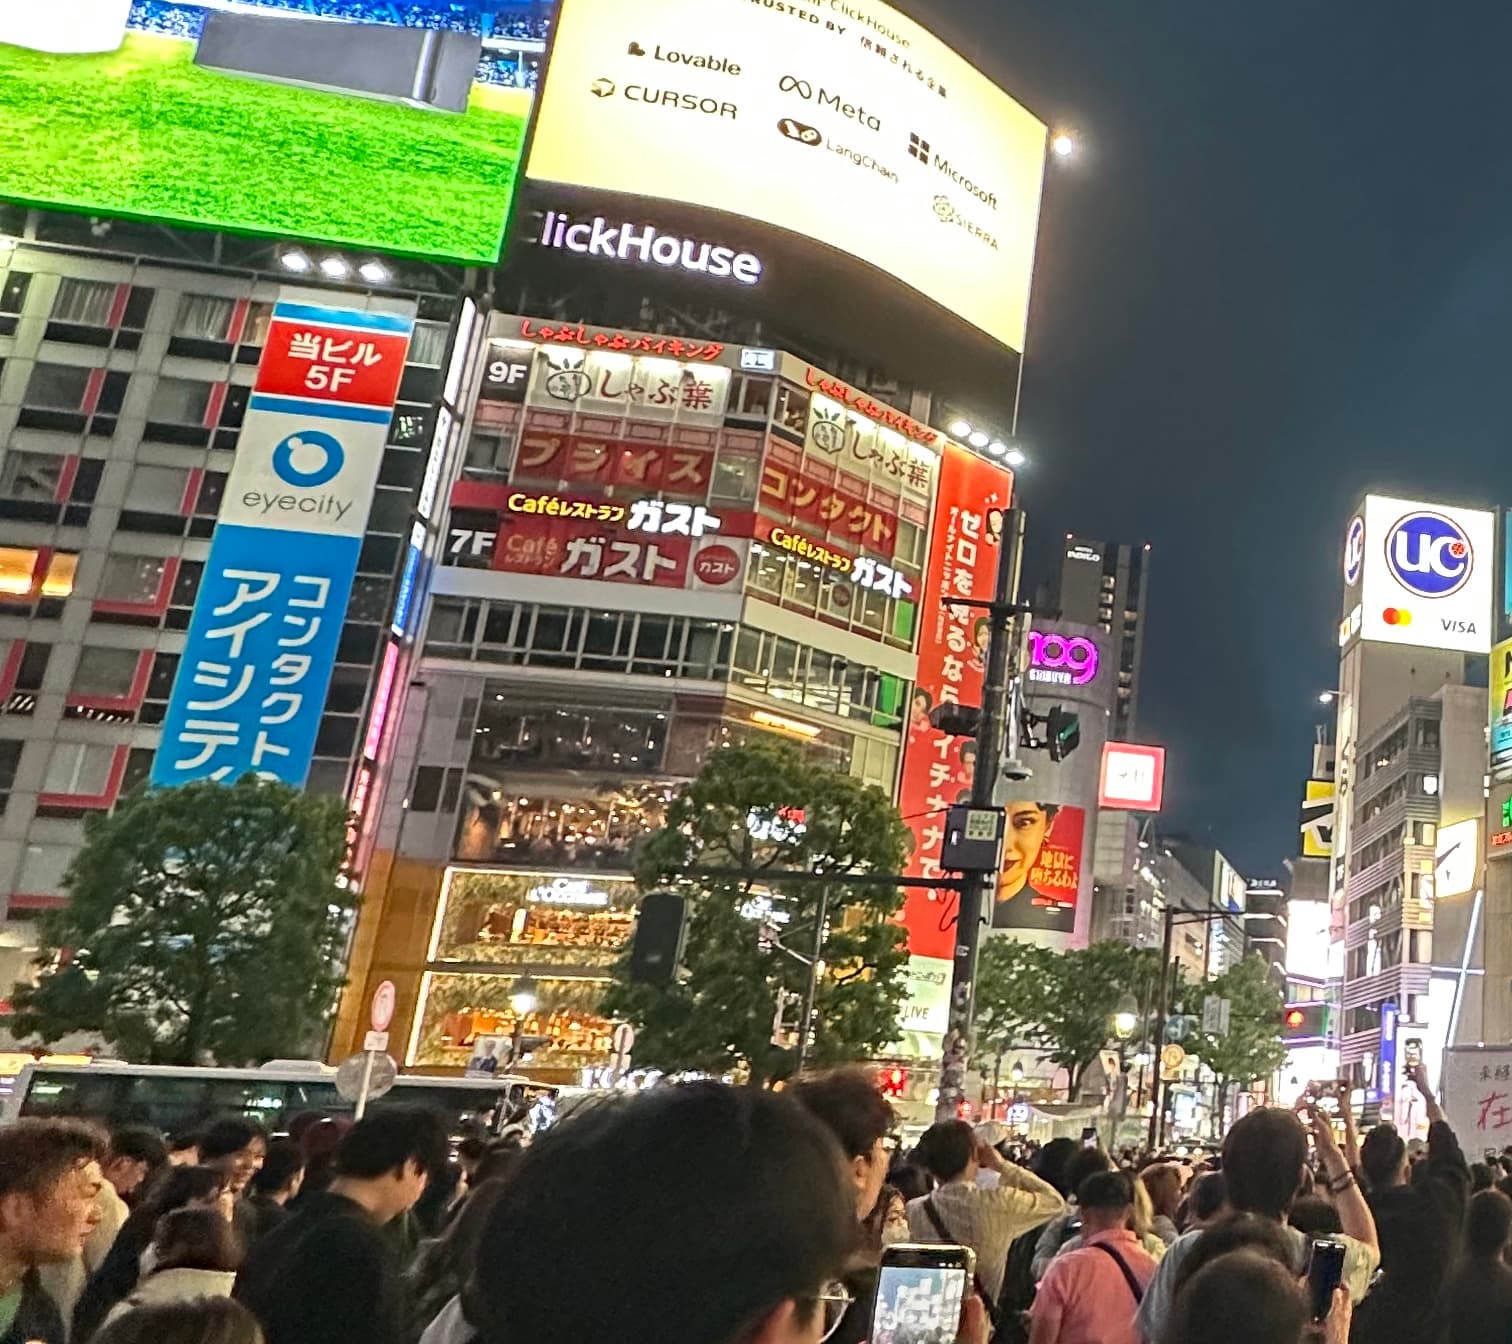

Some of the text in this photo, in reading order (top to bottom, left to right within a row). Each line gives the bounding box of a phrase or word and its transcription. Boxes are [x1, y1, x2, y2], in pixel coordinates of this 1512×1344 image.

[826, 20, 846, 35] BY
[654, 44, 742, 77] Lovable
[624, 83, 738, 120] CURSOR
[817, 88, 881, 132] Meta
[826, 137, 900, 185] LangChain
[934, 154, 997, 210] Microsoft
[955, 212, 999, 252] SIERRA
[287, 332, 384, 368] 当ビル
[521, 319, 724, 361] しゃぶしゃぶバイキング
[304, 365, 356, 393] 5F
[488, 361, 528, 385] 9F
[600, 370, 714, 410] しゃぶ葉
[805, 367, 938, 443] しゃぶしゃぶバイキング
[522, 437, 704, 484] プライス
[853, 430, 930, 489] しゃぶ葉
[242, 490, 353, 524] eyecity
[626, 499, 722, 537] ガスト
[762, 467, 891, 542] コンタクト
[450, 529, 497, 555] 7F
[506, 534, 558, 556] Café
[560, 537, 677, 581] ガスト
[1396, 530, 1466, 579] UC
[699, 560, 736, 574] ガスト
[851, 557, 913, 599] ガスト
[1441, 619, 1478, 635] VISA
[173, 568, 282, 782] アイシテ
[1028, 631, 1098, 685] 109
